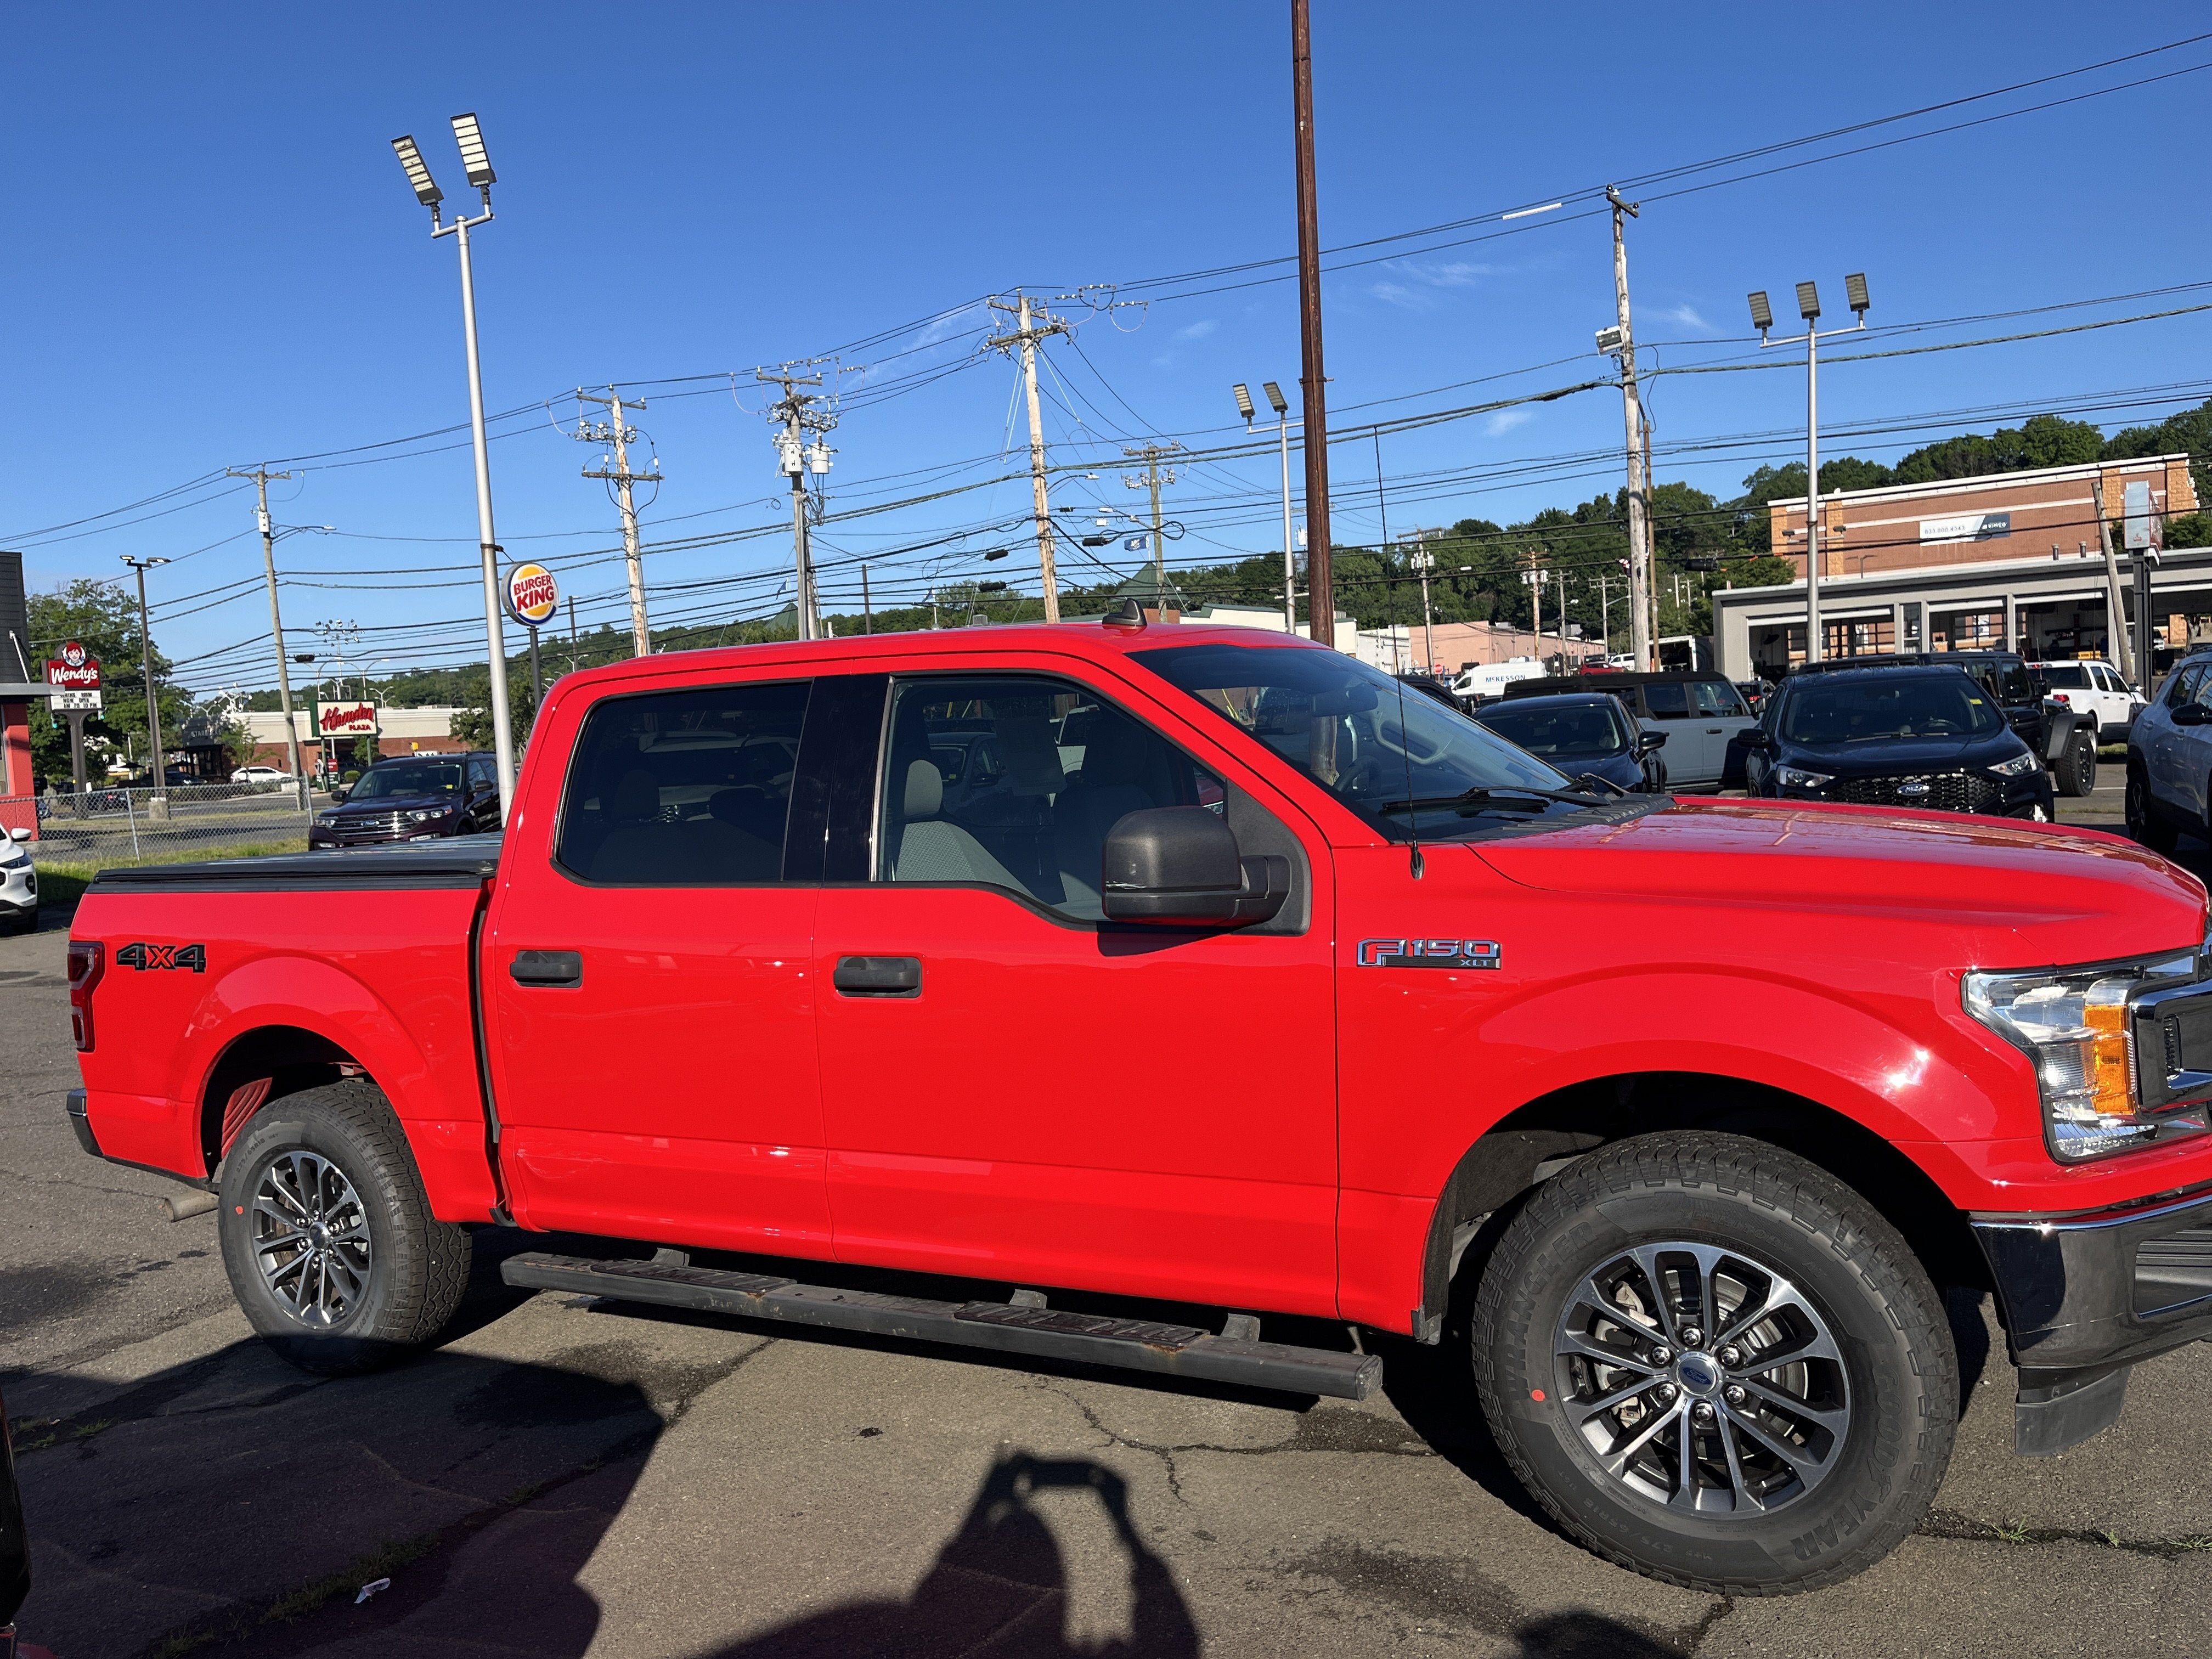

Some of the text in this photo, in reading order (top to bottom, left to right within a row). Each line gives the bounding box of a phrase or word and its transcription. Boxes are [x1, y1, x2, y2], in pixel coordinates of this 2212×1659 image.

[514, 575, 552, 596] BURGER
[517, 585, 554, 613] KING
[51, 666, 98, 684] Wendy's
[320, 702, 374, 732] Hamden
[1504, 1221, 1597, 1401] WRANGLER
[1686, 1369, 1708, 1383] Ford
